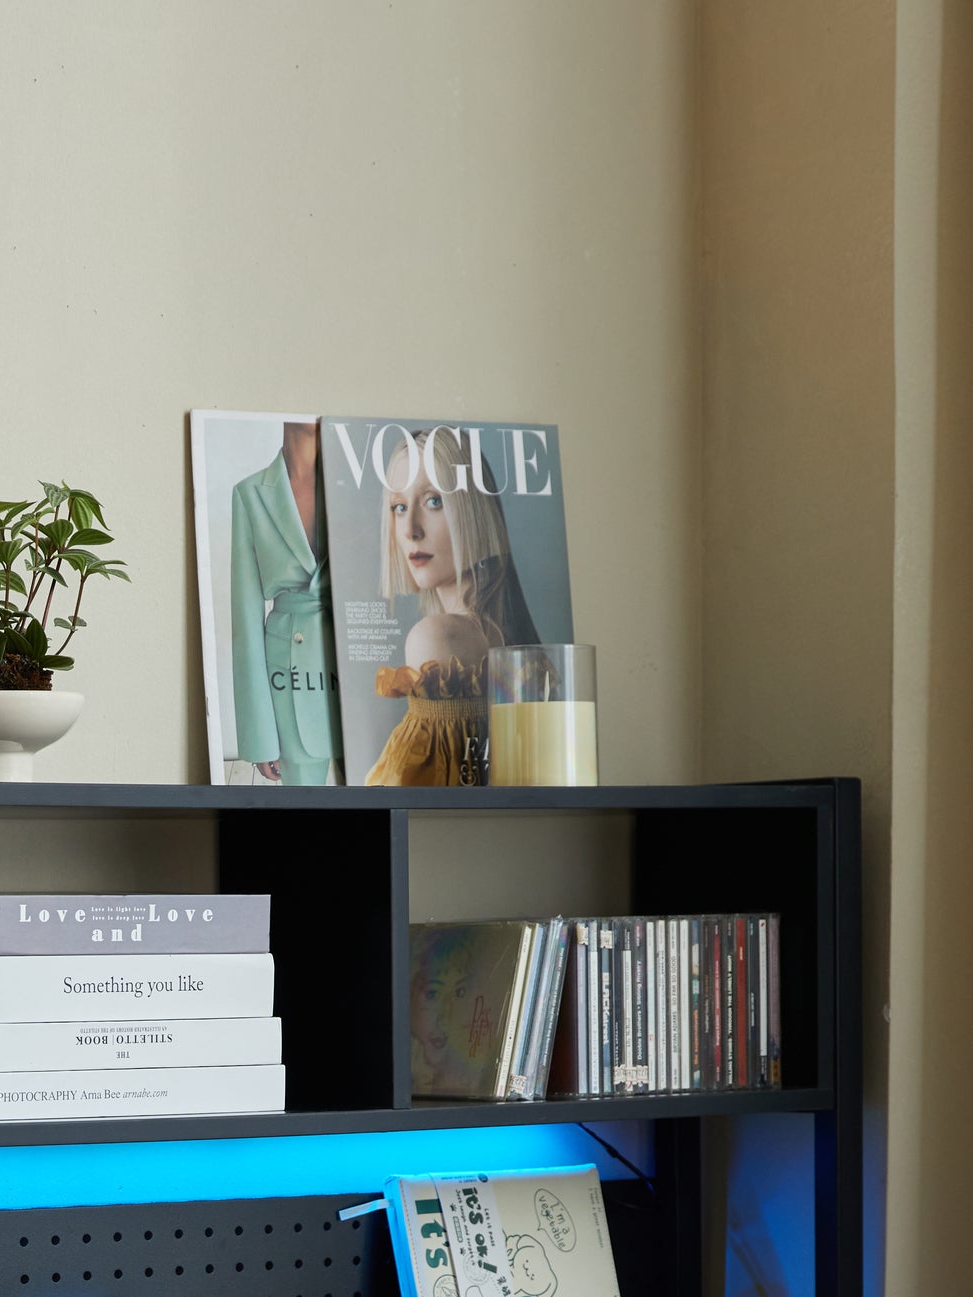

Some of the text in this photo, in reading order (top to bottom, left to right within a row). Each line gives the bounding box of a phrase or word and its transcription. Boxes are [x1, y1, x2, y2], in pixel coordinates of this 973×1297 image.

[329, 423, 552, 495] VOGUE
[19, 903, 214, 923] Love Love
[91, 924, 143, 942] and
[671, 974, 676, 982] SO
[63, 975, 204, 998] Something you like
[671, 997, 677, 1005] SO
[75, 1034, 173, 1046] STILETTO BOOK
[116, 1051, 130, 1059] THE
[104, 1089, 121, 1100] Bee
[538, 1195, 566, 1248] vegetable
